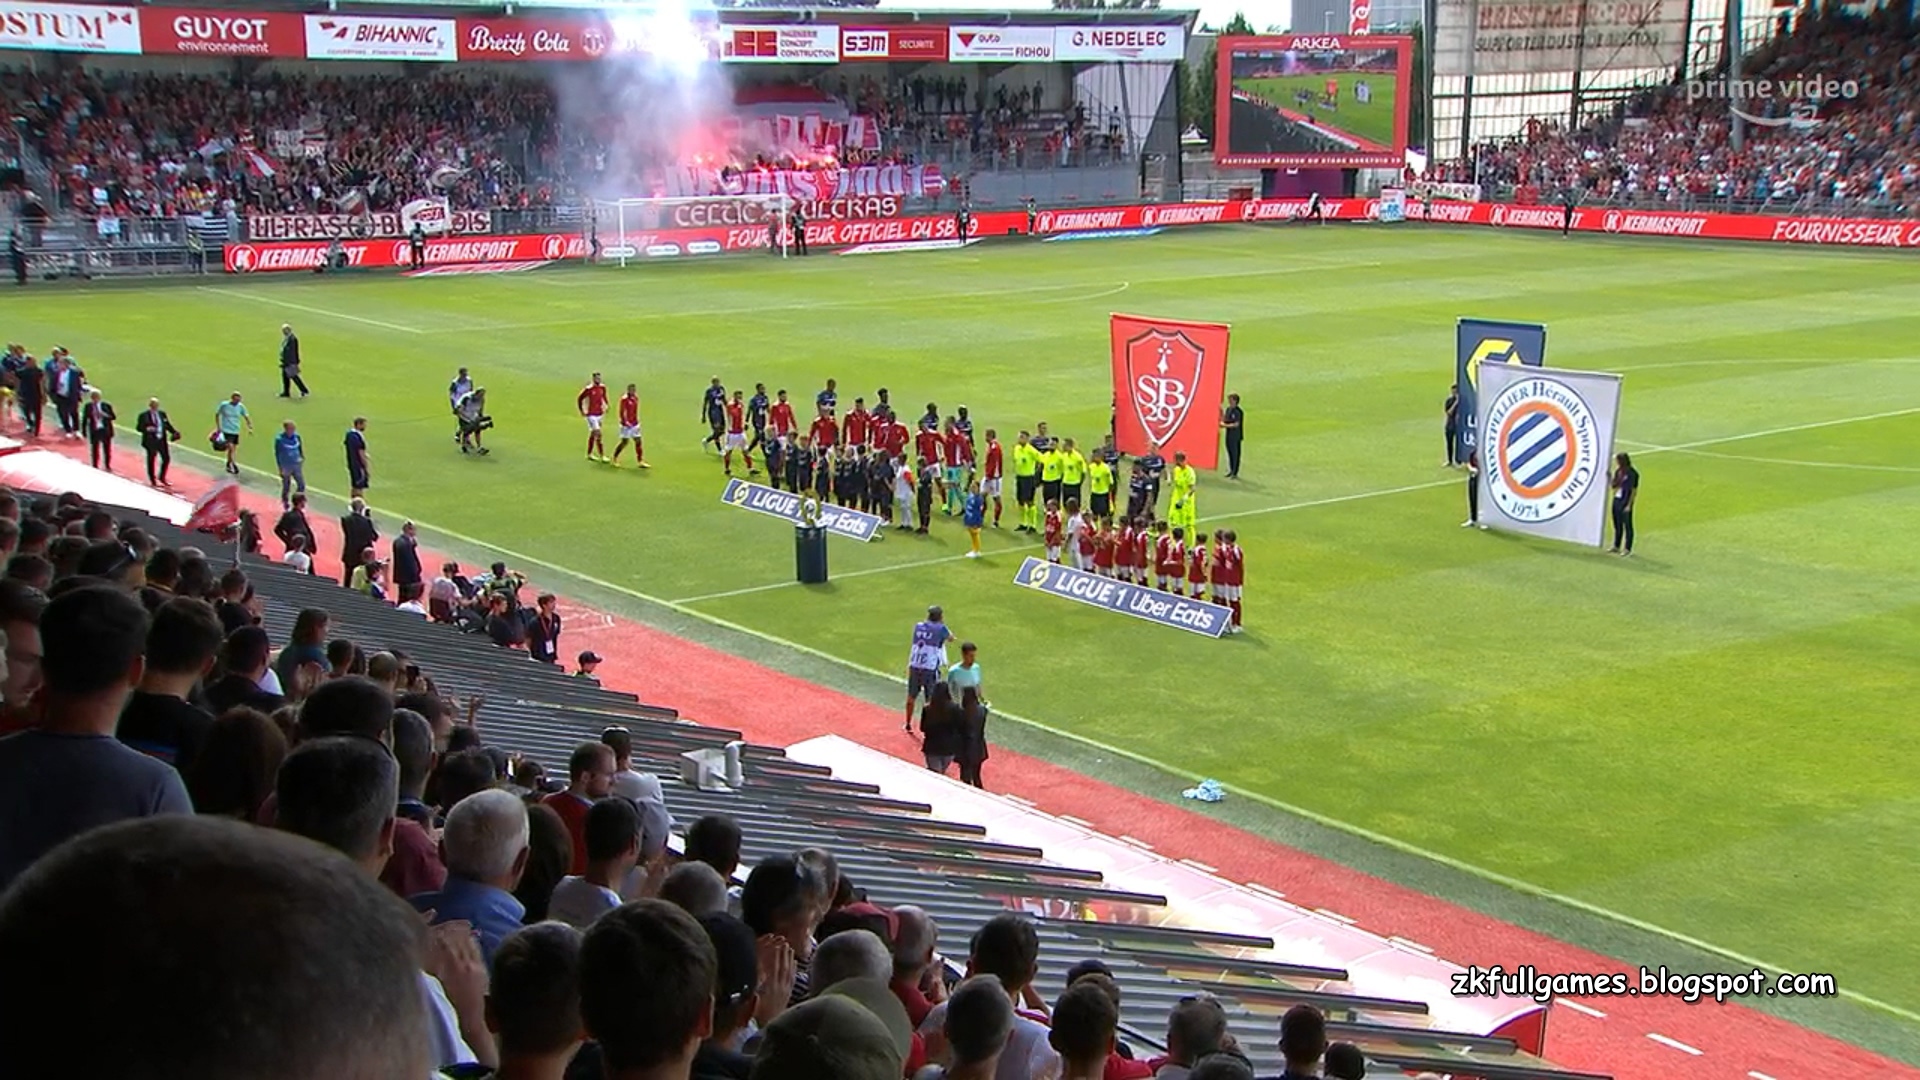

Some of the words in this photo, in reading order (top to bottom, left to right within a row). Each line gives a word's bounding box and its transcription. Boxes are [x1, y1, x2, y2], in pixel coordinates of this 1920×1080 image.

[0, 11, 103, 40] STUM
[173, 16, 268, 40] GUYOT
[355, 24, 437, 43] BIHANNIC
[178, 41, 269, 53] environnement
[468, 25, 526, 56] Breizh
[533, 29, 570, 52] Cola
[1015, 47, 1051, 57] FICHOU
[780, 49, 836, 58] CONSTRUCTION
[674, 201, 758, 227] CELTIC
[800, 197, 897, 221] ULTRAS
[1055, 212, 1125, 229] KERMASPORT
[1158, 206, 1226, 223] KERMASPORT
[255, 216, 343, 237] ULTRAS
[840, 221, 907, 242] OFFICIEL
[911, 218, 931, 238] DU
[1623, 216, 1708, 235] KERMASPORT
[1772, 220, 1902, 246] FOURNISSEUR
[1137, 374, 1186, 409] SB
[1145, 405, 1175, 428] 29
[1575, 413, 1591, 461] Sport
[1562, 460, 1591, 501] Club
[752, 490, 799, 514] LIGUE
[836, 514, 868, 535] Eats
[1511, 501, 1540, 518] 1974
[1055, 572, 1114, 603] LIGUE
[1117, 589, 1125, 606] 1
[1130, 590, 1172, 620] Uber
[1170, 602, 1214, 629] Eats
